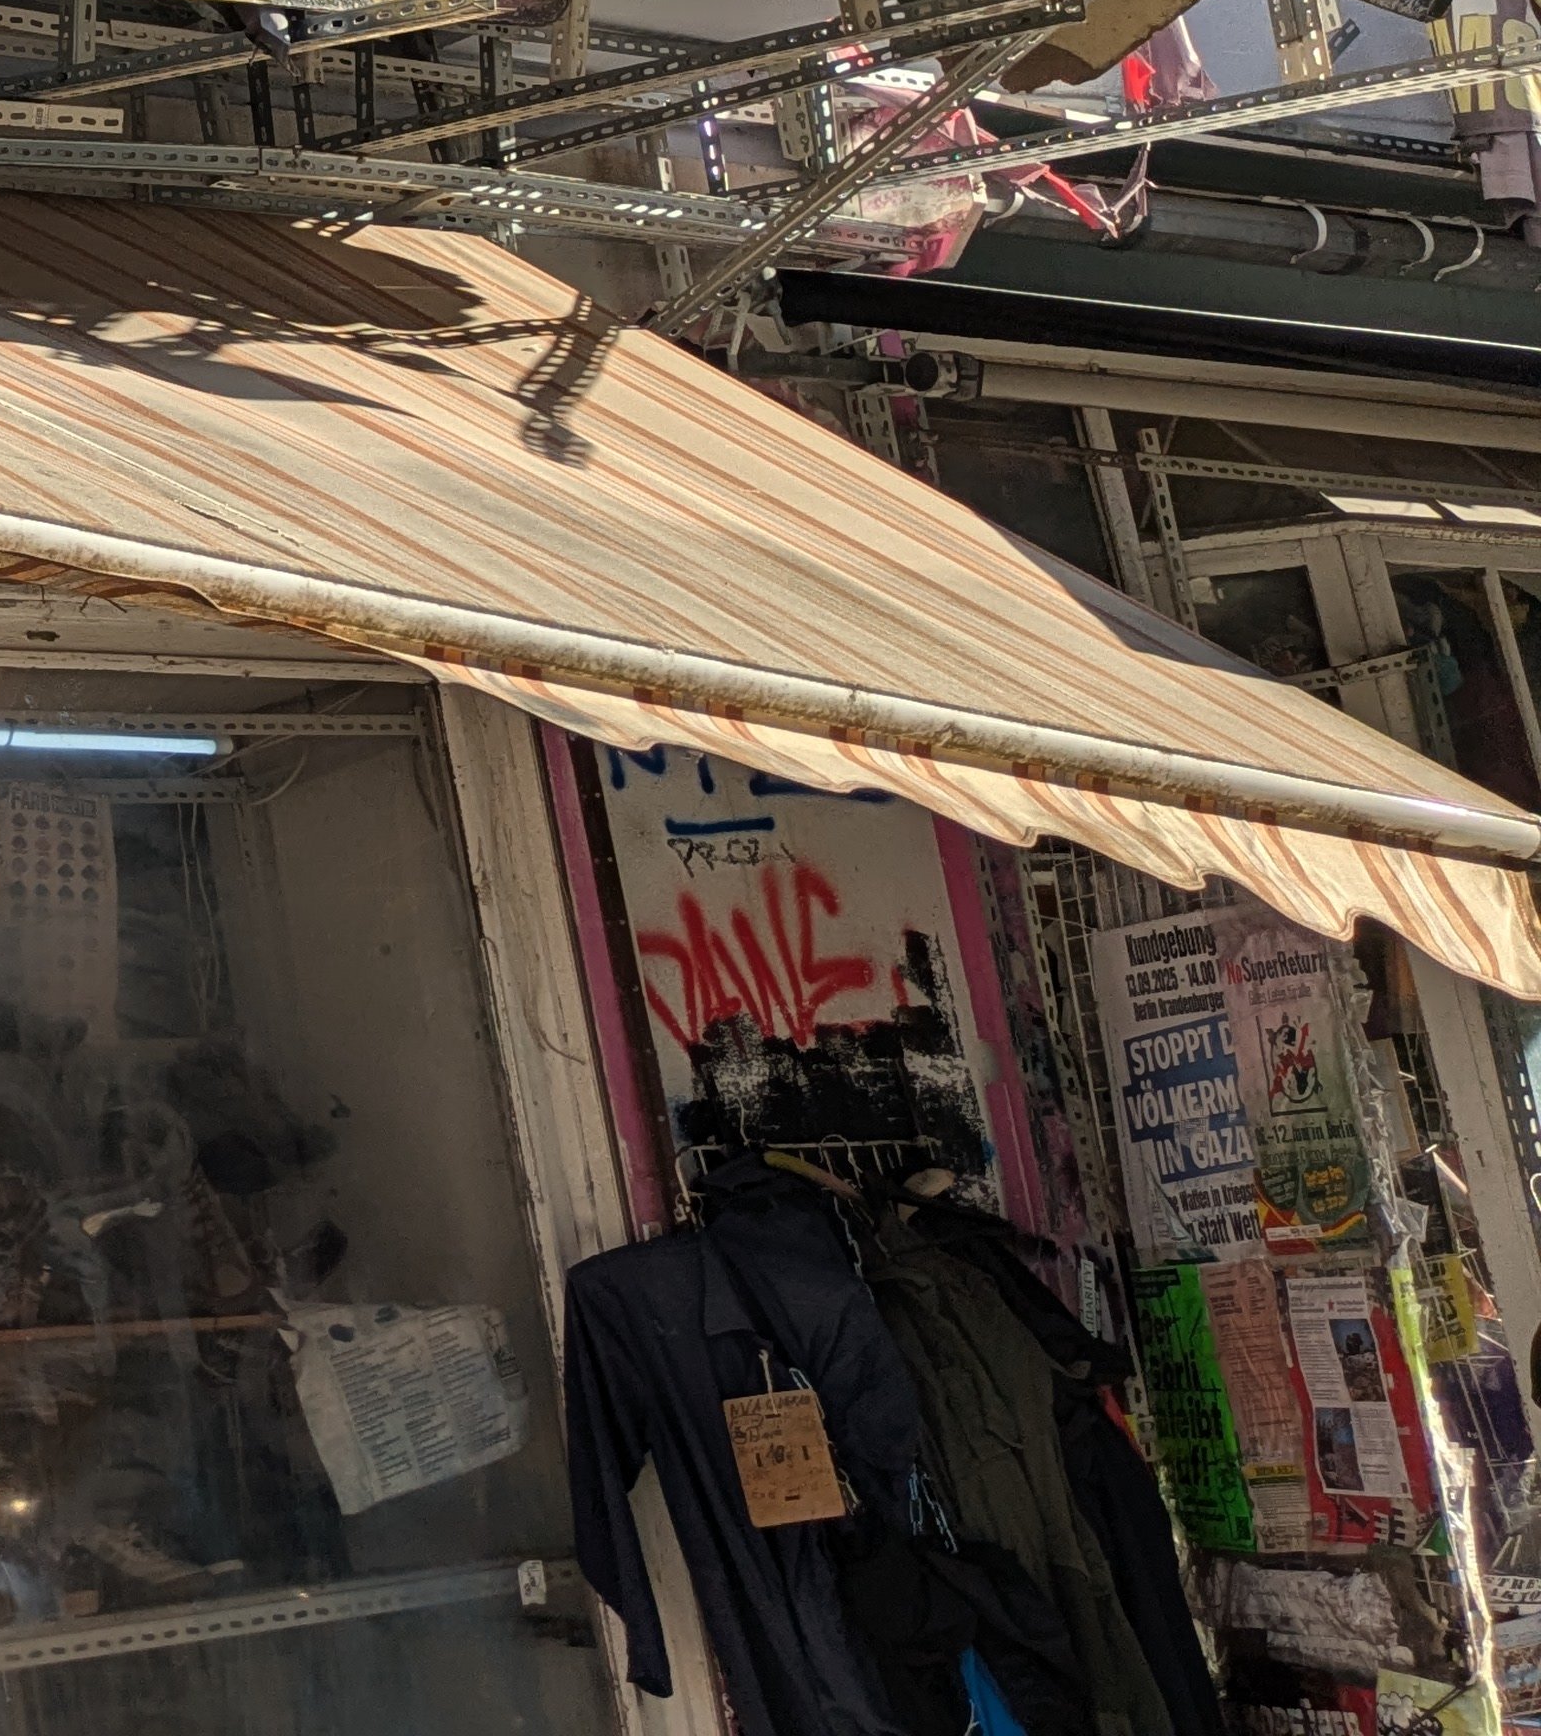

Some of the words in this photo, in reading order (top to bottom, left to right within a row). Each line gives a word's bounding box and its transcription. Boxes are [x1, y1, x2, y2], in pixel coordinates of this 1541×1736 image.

[1125, 924, 1217, 966] Kundgebung
[1130, 1024, 1214, 1076] STOPPT
[1157, 1138, 1186, 1176] IN
[1189, 1125, 1255, 1169] GAZA
